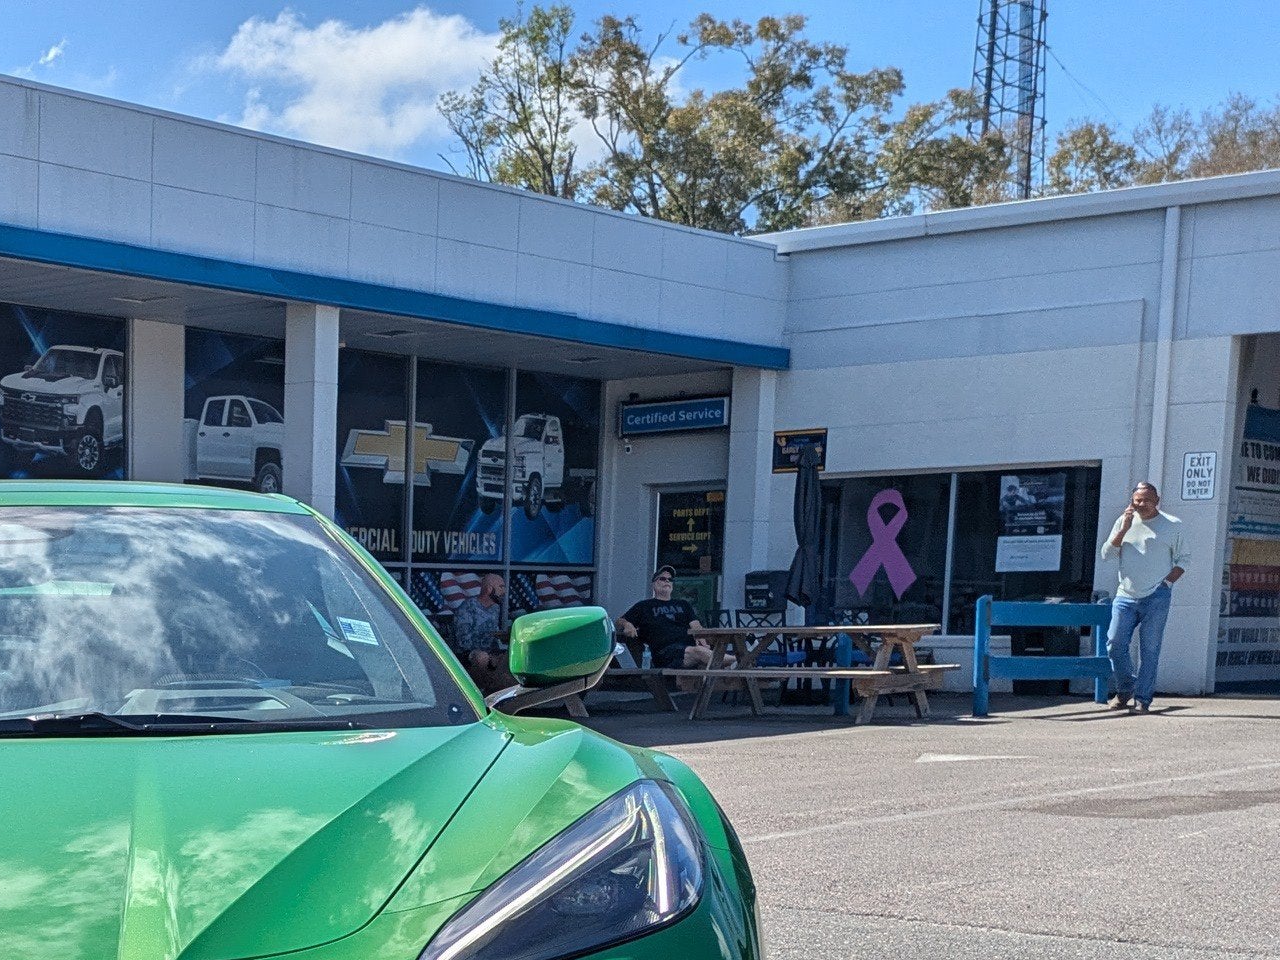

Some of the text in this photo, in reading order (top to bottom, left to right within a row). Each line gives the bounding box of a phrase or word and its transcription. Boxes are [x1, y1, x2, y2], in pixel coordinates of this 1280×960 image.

[627, 407, 722, 425] Certified Service
[1190, 456, 1211, 467] EXIT
[1186, 468, 1213, 478] ONLY
[1186, 480, 1211, 488] DO NOT
[1187, 488, 1209, 496] ENTER
[673, 508, 693, 517] PARTS
[347, 526, 497, 555] ERCIAL DUTY VEHICLES
[669, 532, 695, 541] SERVICE
